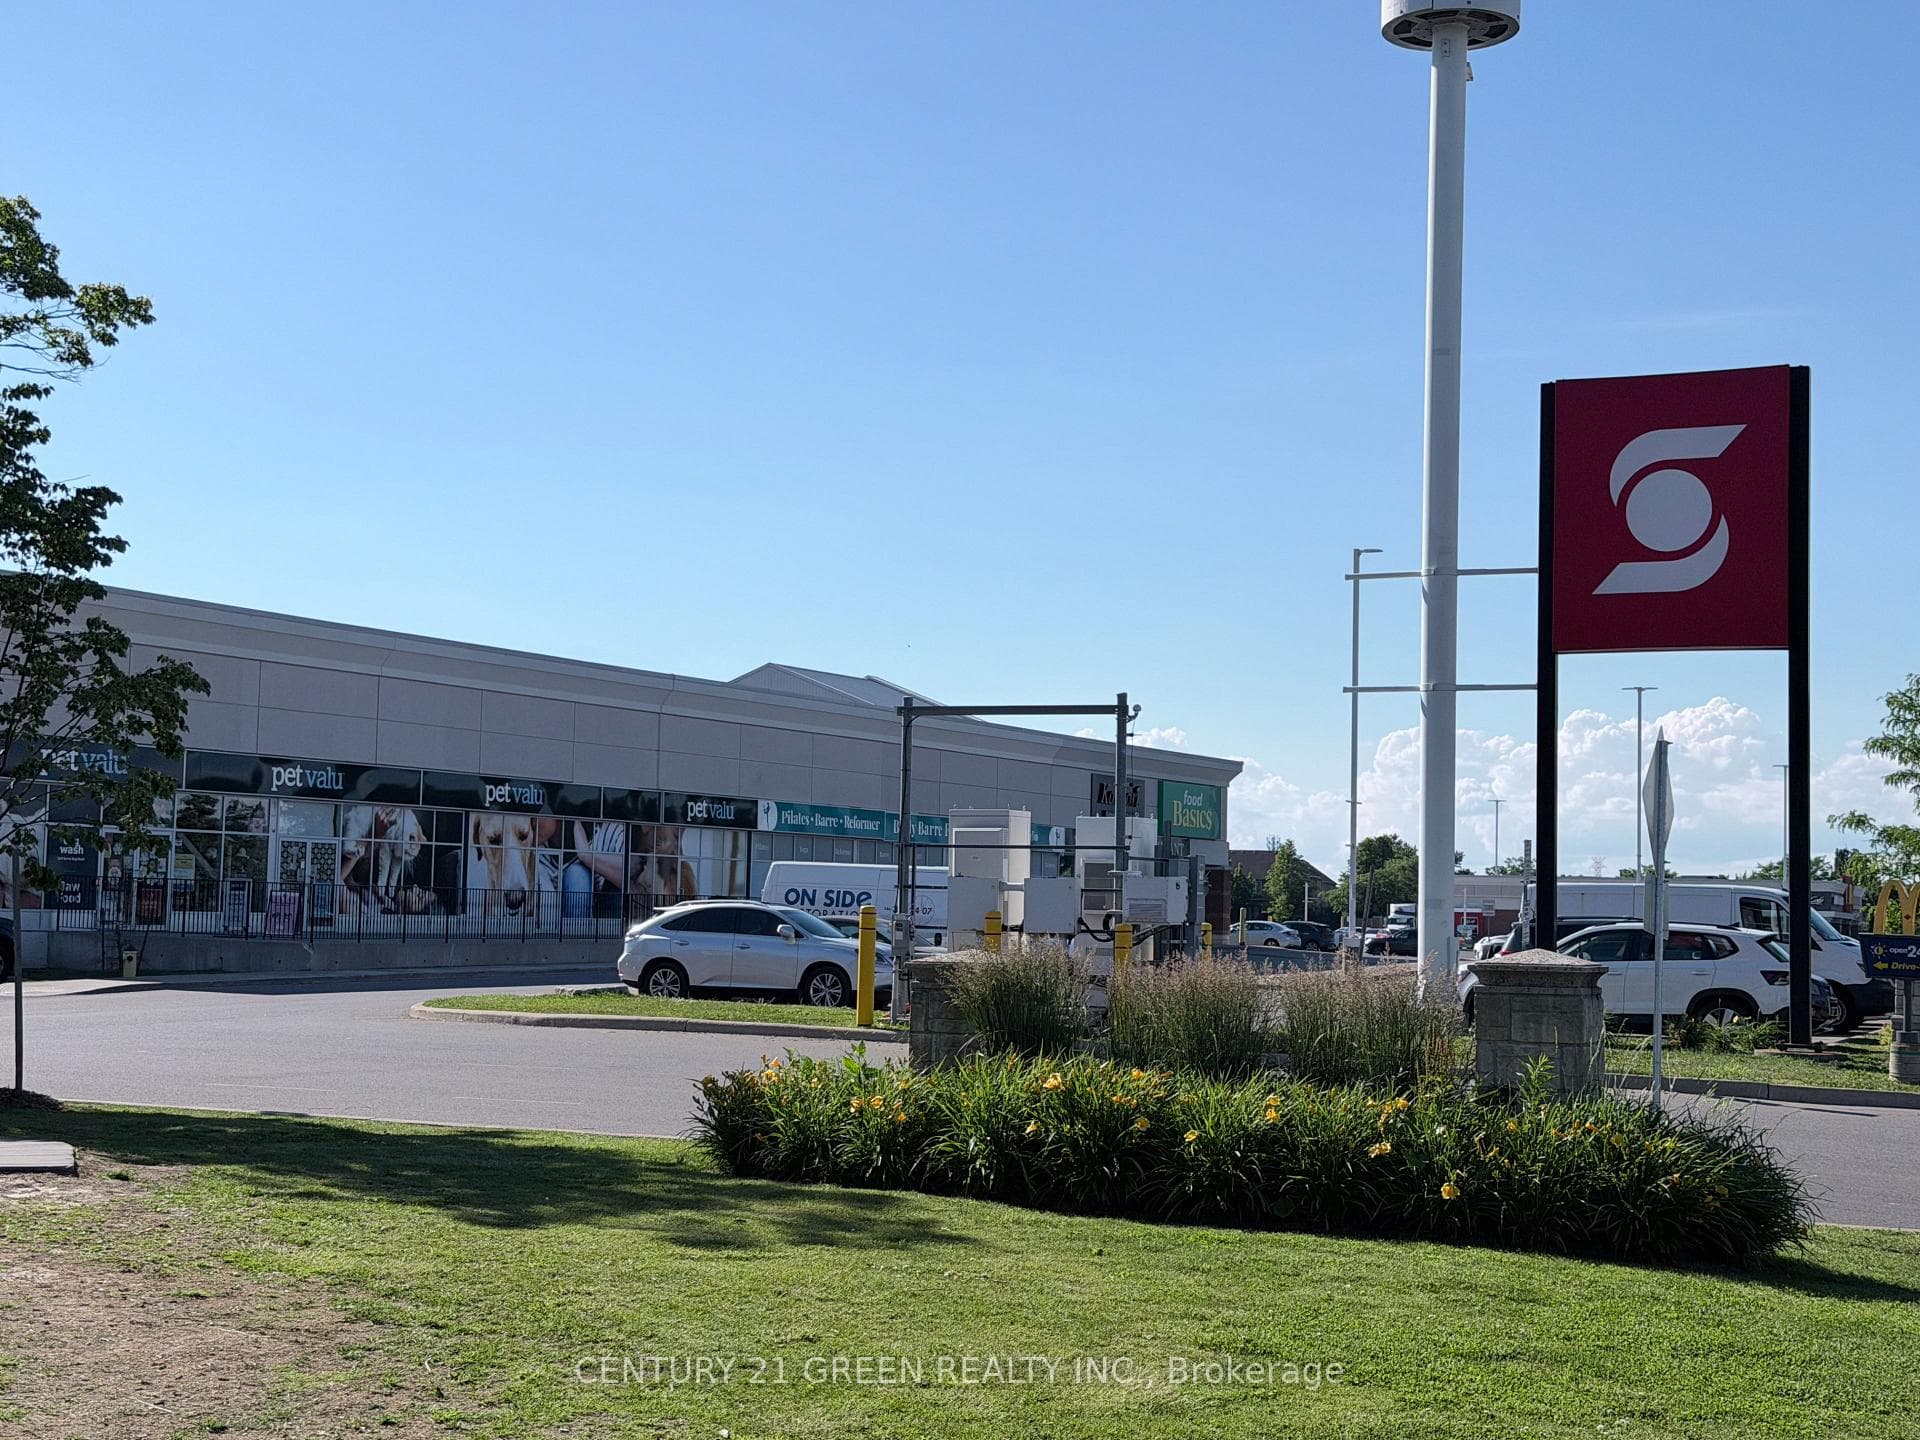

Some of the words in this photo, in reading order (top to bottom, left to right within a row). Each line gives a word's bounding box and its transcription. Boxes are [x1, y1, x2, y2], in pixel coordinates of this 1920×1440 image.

[271, 764, 303, 792] pet
[304, 766, 345, 790] valu
[485, 782, 511, 807] pet
[512, 784, 544, 805] valu
[1183, 790, 1203, 807] food
[687, 800, 708, 821] pet
[708, 801, 736, 820] valu
[781, 810, 810, 826] Pilates
[815, 813, 839, 828] Barre
[844, 815, 881, 831] Reformer
[1172, 800, 1213, 831] Basics
[918, 821, 943, 837] Barre
[59, 844, 84, 855] wash
[784, 888, 817, 906] ON
